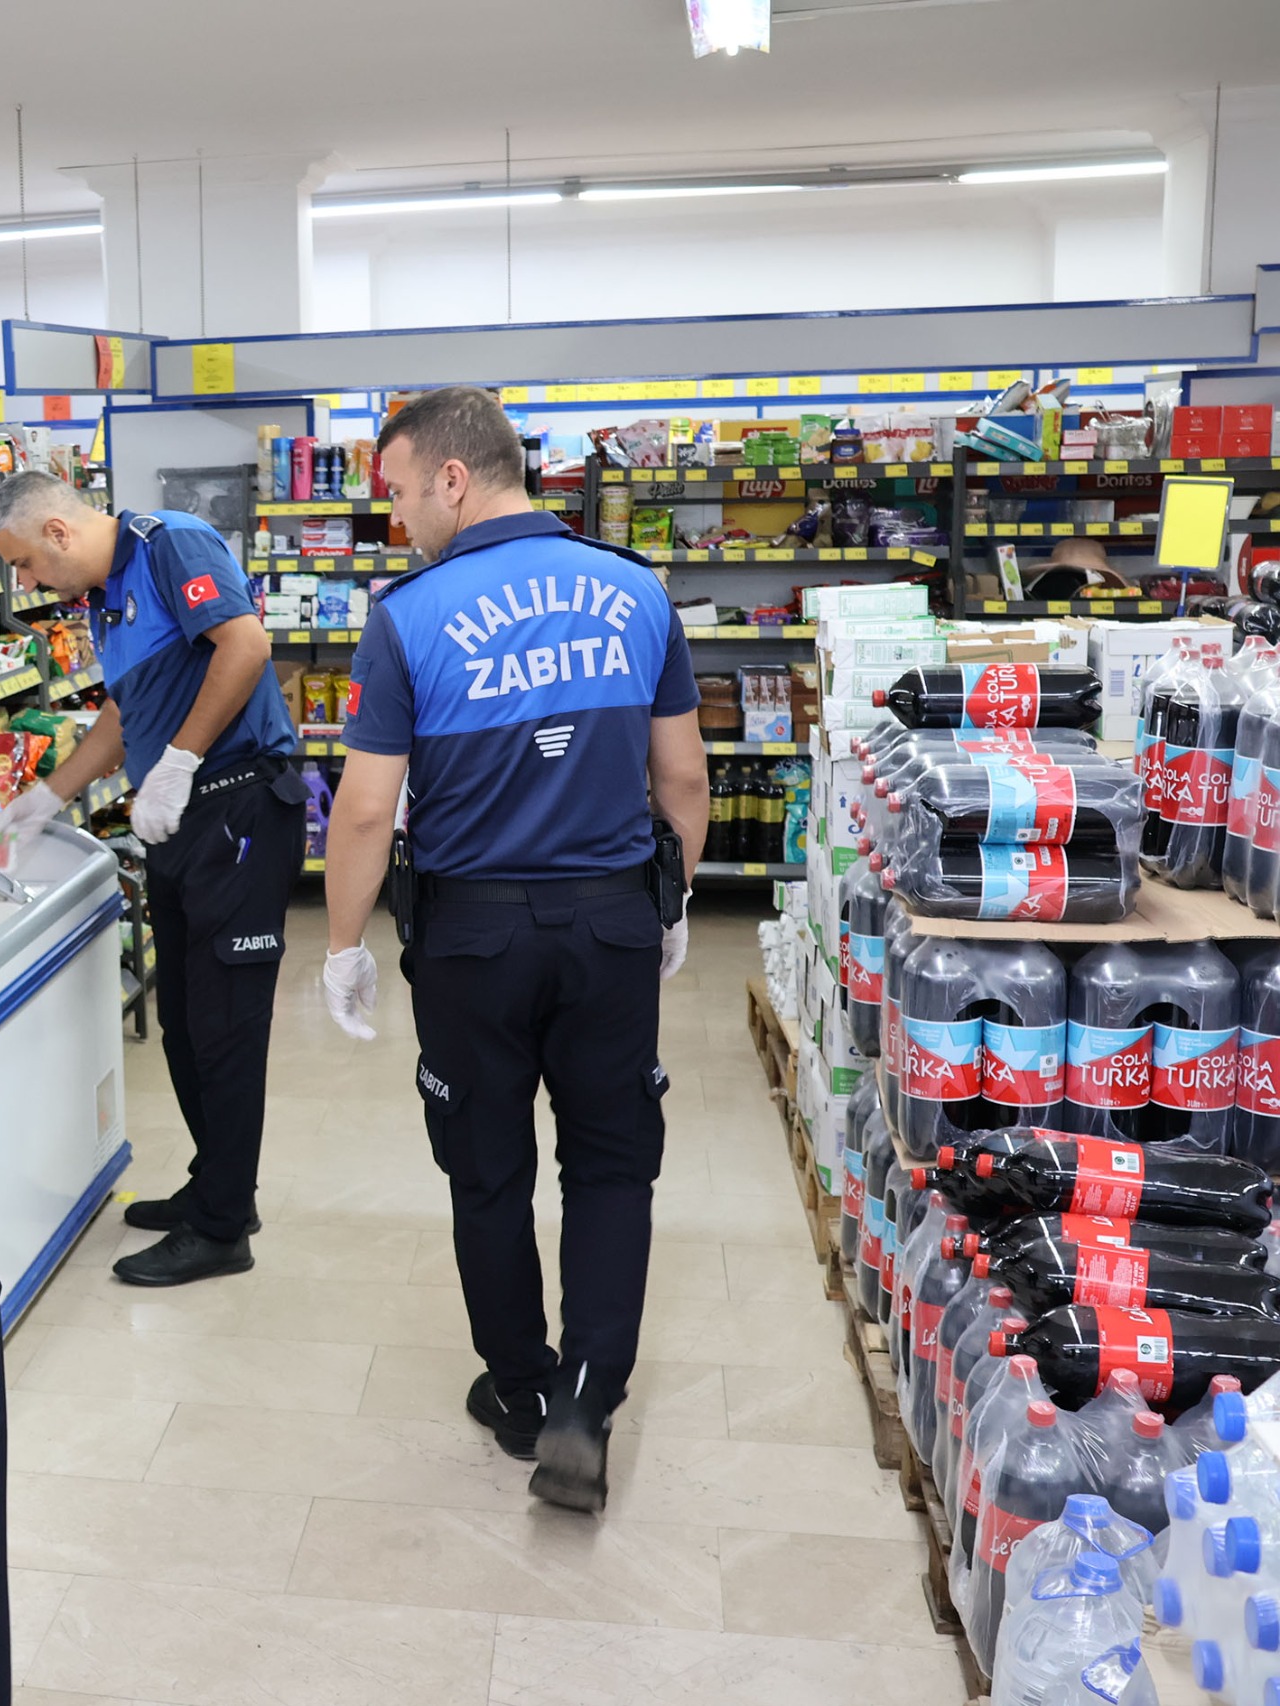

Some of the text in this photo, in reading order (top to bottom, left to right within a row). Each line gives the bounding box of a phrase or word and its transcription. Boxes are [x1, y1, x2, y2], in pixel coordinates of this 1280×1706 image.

[1097, 474, 1152, 487] Doritos
[465, 635, 630, 701] ZABITA
[987, 668, 999, 704] COLA
[199, 771, 255, 795] ZABITA
[1198, 772, 1230, 786] COL
[232, 934, 278, 952] ZABITA
[901, 1056, 955, 1080] URKA
[1111, 1053, 1149, 1067] COLA
[1199, 1054, 1235, 1069] COLA
[419, 1063, 450, 1101] ZABITA
[982, 1061, 1016, 1085] RKA
[1080, 1064, 1150, 1088] TURKA
[1165, 1065, 1235, 1089] TURKA
